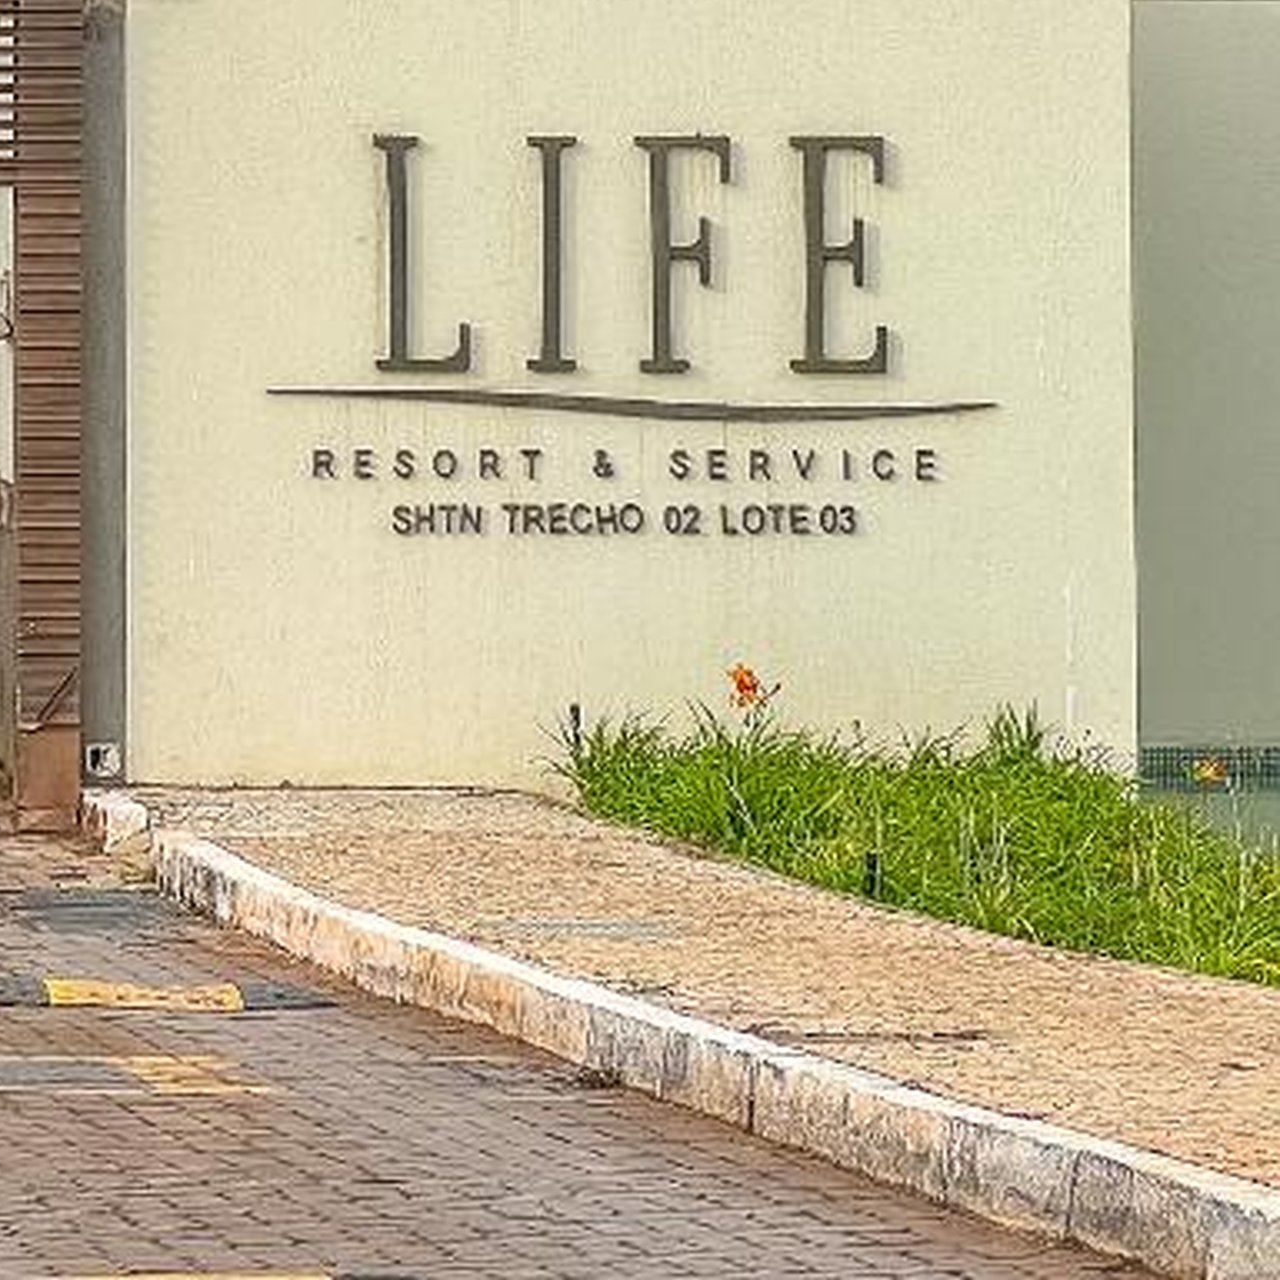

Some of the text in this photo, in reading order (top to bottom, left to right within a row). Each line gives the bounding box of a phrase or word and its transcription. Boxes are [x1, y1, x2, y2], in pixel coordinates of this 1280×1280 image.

[372, 134, 888, 375] LIFE
[311, 449, 936, 481] RESORT & SERVICE
[391, 503, 858, 536] SHTN TRECHO 02 LOTE 03
